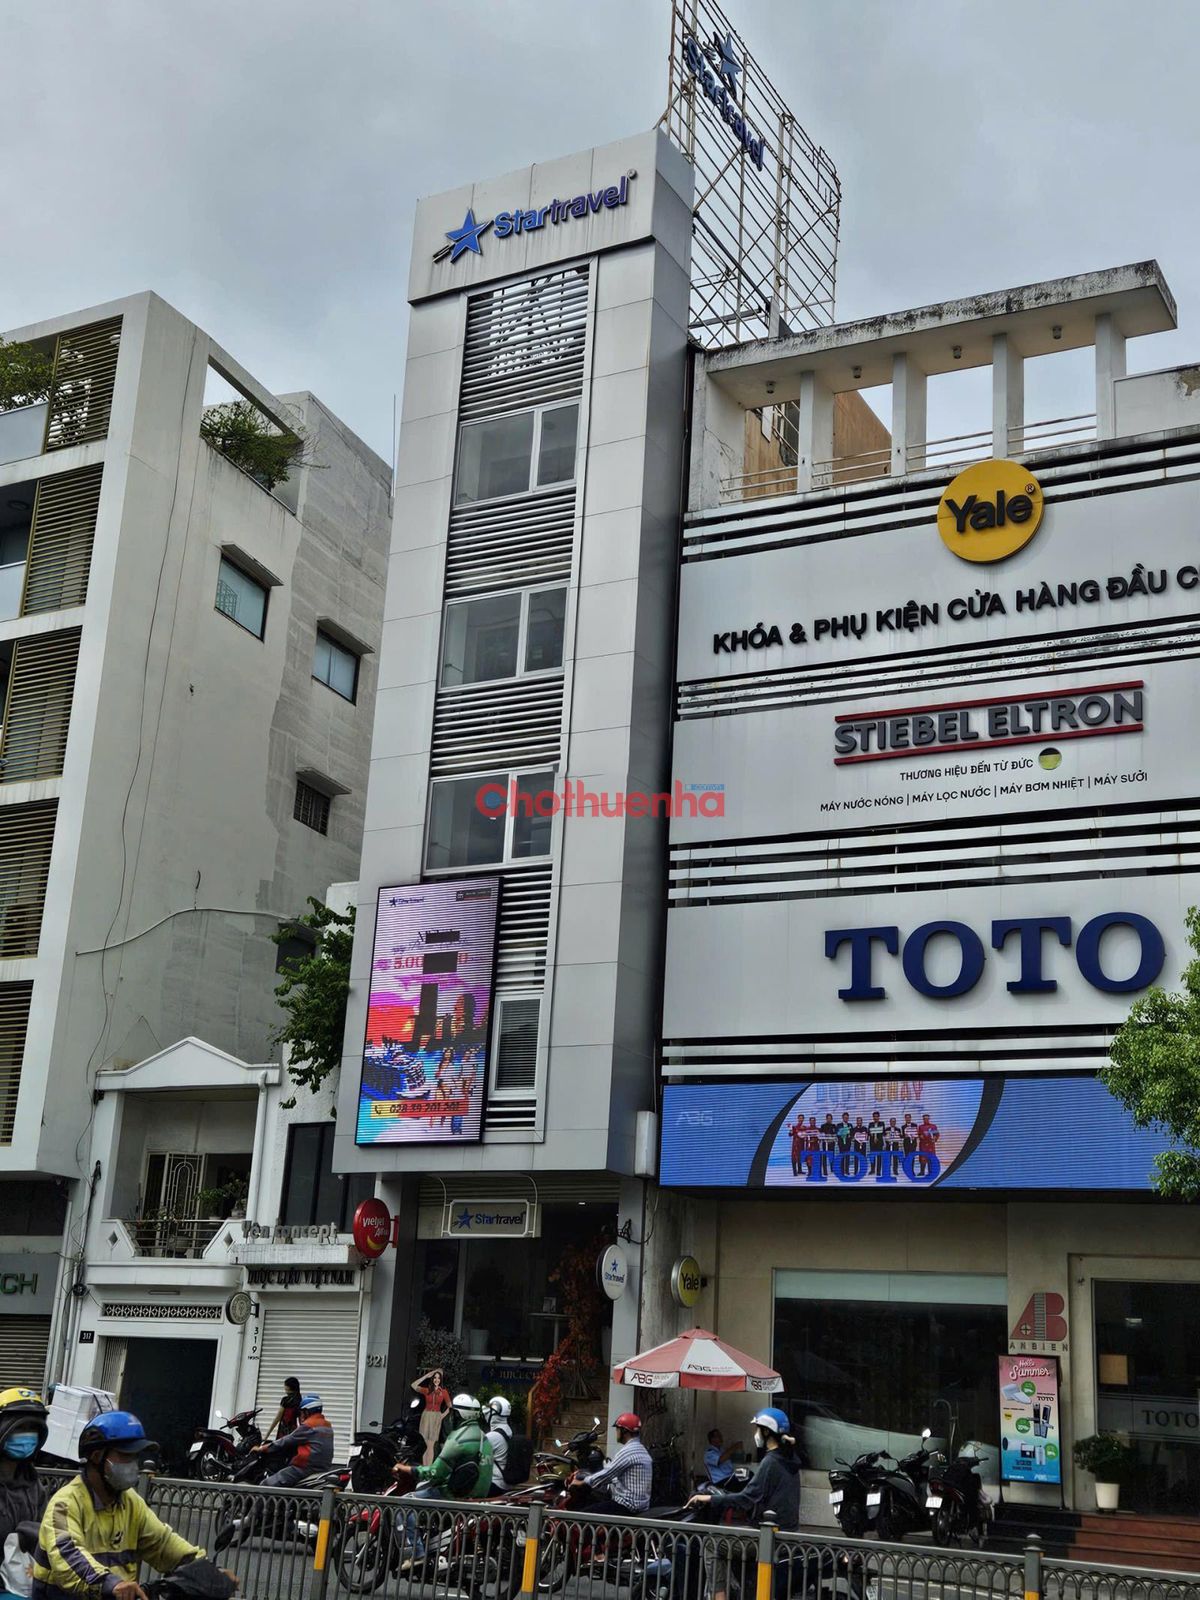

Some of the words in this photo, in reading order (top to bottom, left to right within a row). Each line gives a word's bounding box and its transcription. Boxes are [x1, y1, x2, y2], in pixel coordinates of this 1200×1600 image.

[493, 174, 629, 239] Startravel
[944, 489, 1034, 534] Yale
[713, 621, 783, 654] KHÓA
[789, 622, 807, 645] &
[814, 612, 868, 641] PHỤ
[876, 599, 940, 633] KIỆN
[947, 588, 1006, 621] CỬA
[1015, 580, 1101, 612] HÀNG
[1106, 562, 1168, 600] ĐẦU
[834, 711, 979, 755] STIEBEL
[987, 690, 1144, 738] ELTRON
[899, 768, 942, 782] THƯƠNG
[944, 764, 968, 779] HIỆU
[970, 761, 991, 775] ĐẾN
[993, 758, 1009, 773] TỪ
[1010, 757, 1034, 770] ĐỨC
[820, 800, 842, 813] MÁY
[843, 797, 873, 811] NƯỚC
[874, 795, 904, 808] NÓNG
[912, 790, 934, 804] MÁY
[936, 789, 959, 804] LỌC
[960, 786, 992, 800] NƯỚC
[1000, 782, 1023, 796] MÁY
[1025, 780, 1051, 793] BƠM
[1052, 777, 1084, 791] NHIỆT
[1094, 773, 1118, 786] MÁY
[1120, 769, 1148, 784] SƯỞI
[824, 911, 1166, 1001] TOTO
[801, 1149, 941, 1184] TOTO
[475, 1213, 524, 1226] Startravel
[0, 1272, 39, 1295] CH
[681, 1273, 700, 1291] Yale
[366, 1354, 387, 1368] 321
[1009, 1364, 1051, 1380] Summer
[630, 1372, 654, 1385] ABG
[1141, 1409, 1199, 1429] TOTO
